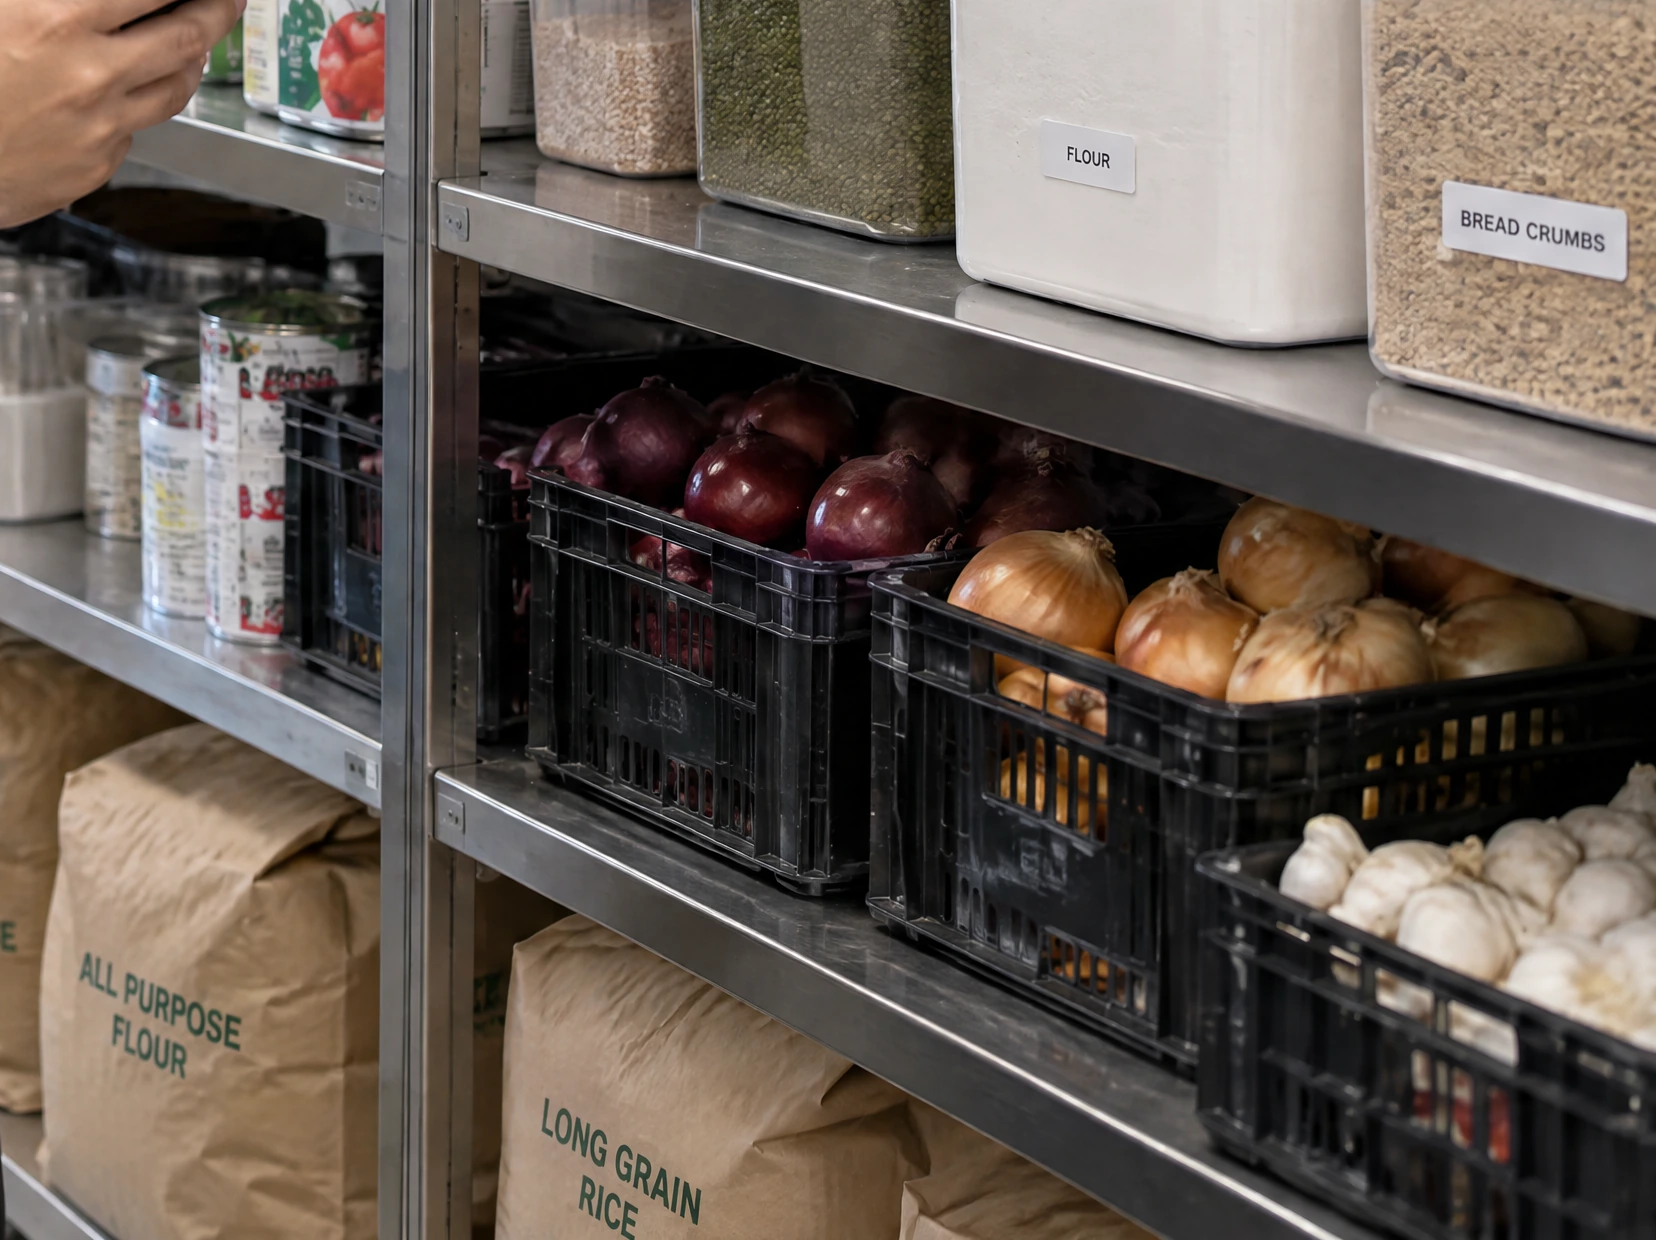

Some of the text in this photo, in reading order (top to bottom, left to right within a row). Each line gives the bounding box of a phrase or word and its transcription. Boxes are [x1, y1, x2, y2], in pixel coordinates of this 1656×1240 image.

[1067, 145, 1111, 169] FLOUR
[1460, 209, 1606, 253] BREAD CRUMBS
[79, 951, 243, 1052] ALL PURPOSE
[112, 1013, 188, 1080] FLOUR
[541, 1097, 702, 1226] LONG GRAIN
[578, 1174, 639, 1240] RICE
